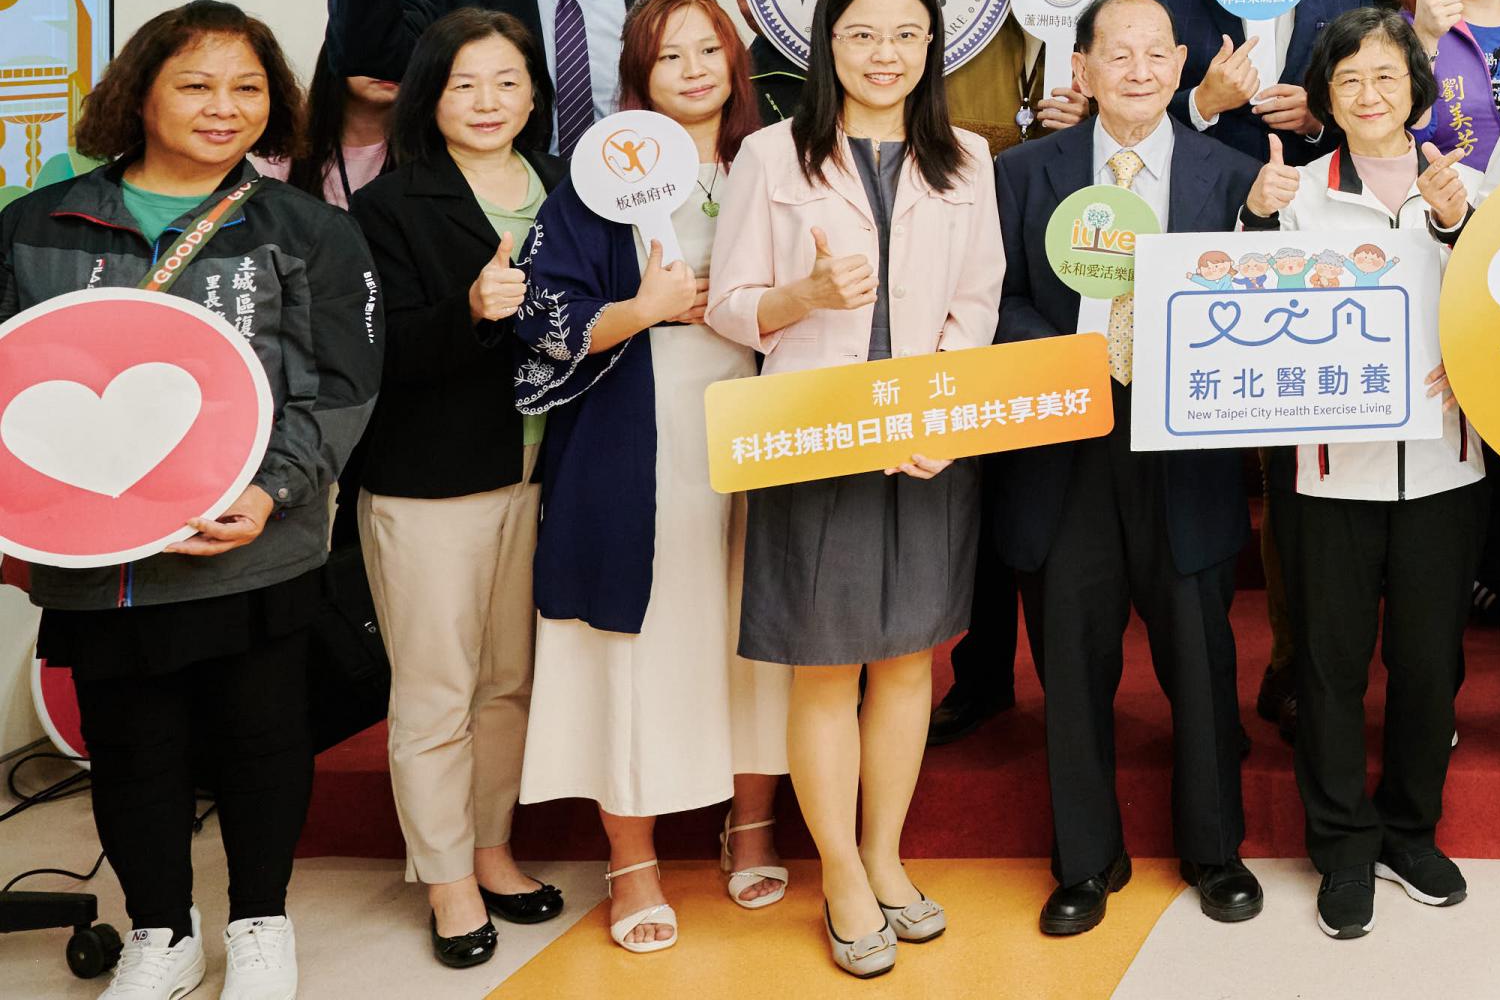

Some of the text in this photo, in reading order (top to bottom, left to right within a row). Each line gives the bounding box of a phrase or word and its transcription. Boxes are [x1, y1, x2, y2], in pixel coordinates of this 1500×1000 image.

[616, 183, 676, 211] 板橋府中
[153, 219, 214, 284] GOODS
[232, 257, 258, 343] 土城區復
[1189, 364, 1391, 401] 新北醫動養
[731, 387, 1092, 465] 科技擁抱日照 青銀共享美好
[1187, 402, 1392, 421] New Taipei City Health Exercise Living
